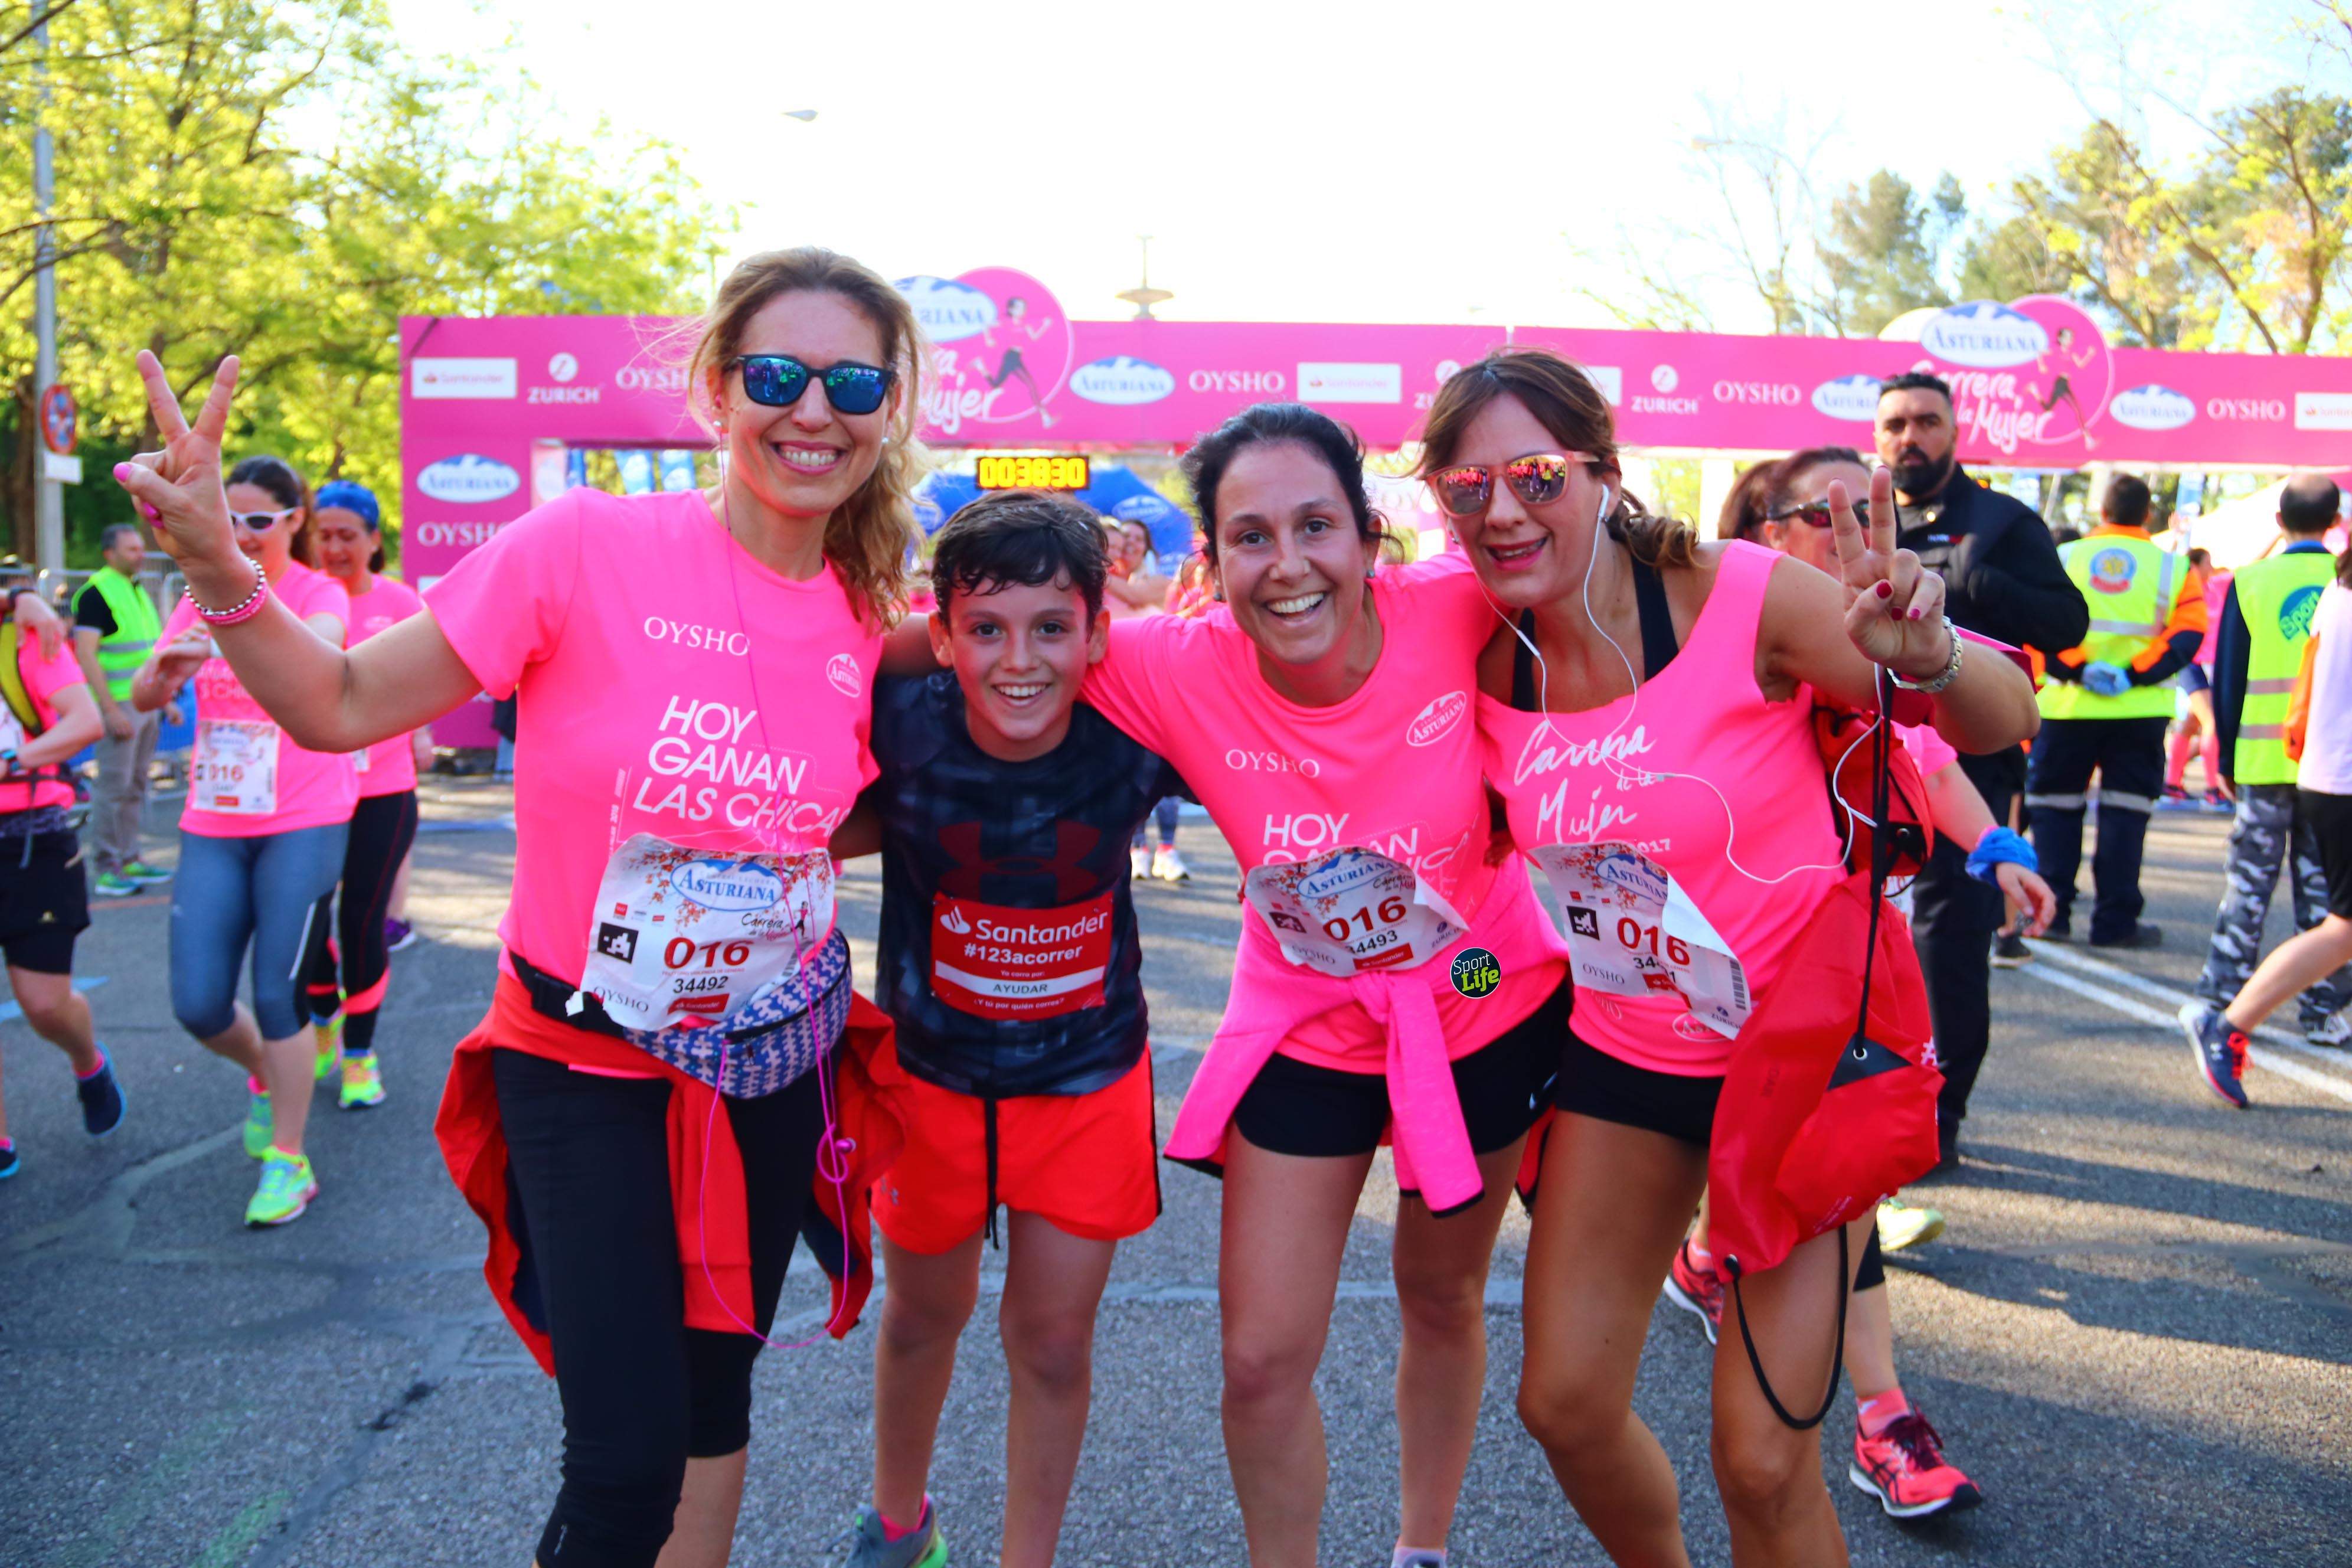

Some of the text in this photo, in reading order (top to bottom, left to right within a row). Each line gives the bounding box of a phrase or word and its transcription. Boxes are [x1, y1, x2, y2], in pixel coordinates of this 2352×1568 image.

[1933, 325, 2039, 351] ASTURIANA
[527, 386, 600, 404] ZURICH
[1080, 374, 1167, 392] ASTURIANA
[1188, 370, 1286, 393] OYSHO
[1713, 381, 1802, 406] OYSHO
[1631, 396, 1699, 414] ZURICH
[2207, 397, 2286, 422] OYSHO
[1966, 396, 2054, 455] Mujer
[644, 616, 750, 656] OYSHO
[658, 695, 757, 744] HOY
[1414, 700, 1464, 742] ASTURIANA
[649, 737, 806, 795] GANAN
[1226, 749, 1319, 778] OYSHO
[1514, 719, 1657, 786] Carrera
[633, 777, 717, 821] LAS
[1536, 778, 1638, 844] Mujer
[1263, 814, 1350, 847] HOY
[1636, 838, 1670, 853] 017
[680, 869, 775, 901] ASTURIANA
[1307, 861, 1393, 895] ASTURIANA
[741, 913, 783, 929] Carrera
[975, 912, 1108, 945] Santander
[1322, 896, 1406, 941] 016
[664, 937, 754, 969] 016
[964, 943, 1083, 965] #123acorrer
[1617, 917, 1690, 966] 016
[1370, 951, 1404, 966] Santander
[673, 976, 729, 994] 34492
[1583, 963, 1625, 985] OYSHO
[594, 986, 648, 1012] OYSHO
[993, 984, 1048, 994] AYUDAR
